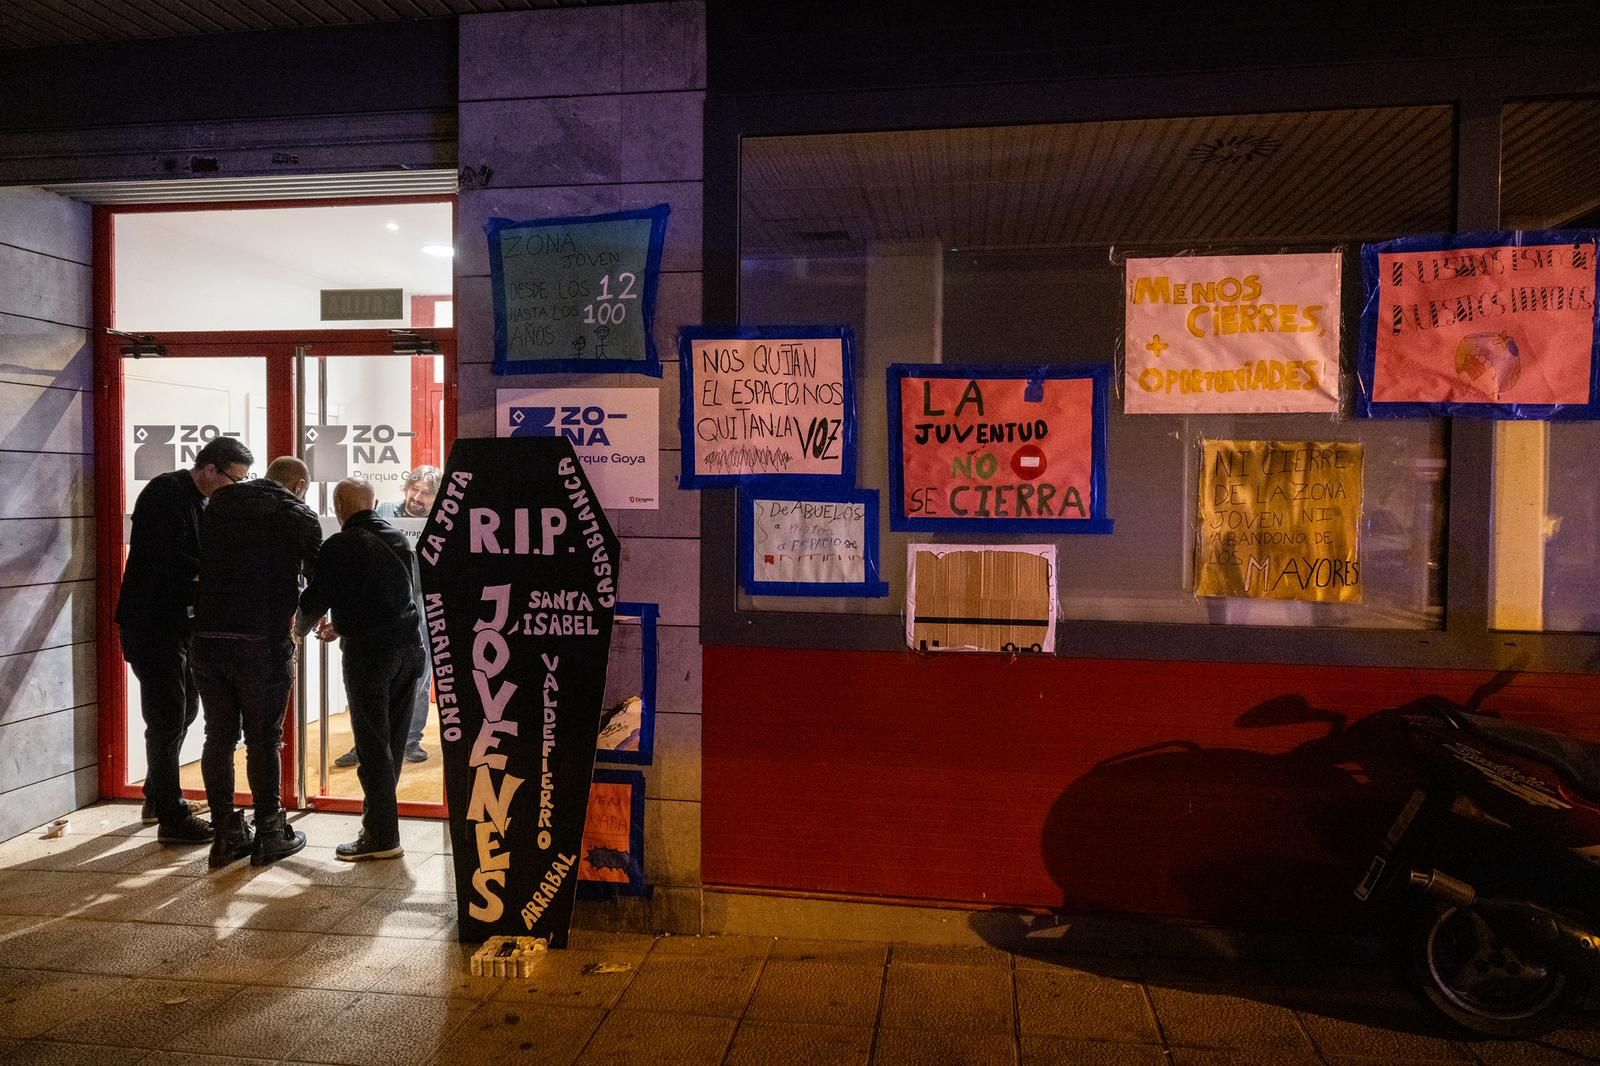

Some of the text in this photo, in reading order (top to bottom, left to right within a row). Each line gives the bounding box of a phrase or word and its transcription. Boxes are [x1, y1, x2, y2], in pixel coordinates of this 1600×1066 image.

[503, 232, 577, 258] ZONA
[561, 251, 620, 269] JOVEN
[511, 272, 637, 301] DESDE LOS 12
[510, 302, 626, 325] HASTA LOS 100
[511, 322, 555, 346] AÑOS
[703, 343, 816, 379] NOS QUITAN
[702, 380, 723, 407] EL
[803, 382, 845, 406] NOS
[923, 380, 984, 416] LA
[560, 427, 611, 446] NA
[697, 408, 774, 442] QUITAN
[776, 414, 792, 438] LA
[793, 416, 842, 461] VOZ
[915, 419, 1048, 445] JUVENTUD
[180, 445, 202, 463] N
[352, 445, 400, 464] NA
[577, 453, 645, 465] rque Goya
[952, 453, 998, 480] NO
[1215, 448, 1347, 479] NI CIERRE
[909, 483, 1087, 518] SE CIERRA
[1214, 482, 1347, 506] DE LA ZONA
[421, 470, 473, 567] LA JOTA
[770, 500, 866, 521] De ABUELOS
[1210, 507, 1333, 530] JOVEN NI
[469, 507, 576, 556] R.I.P.
[558, 457, 615, 609] CASABLANCA
[1212, 531, 1334, 547] ABANDONO DE
[1209, 550, 1360, 593] LOS MAYORES
[528, 589, 595, 611] SANTA
[523, 613, 600, 636] ISABEL
[425, 592, 462, 743] MIRALBUENO
[537, 652, 559, 850] VALDEFIERRO
[519, 852, 577, 930] ARRABAL
